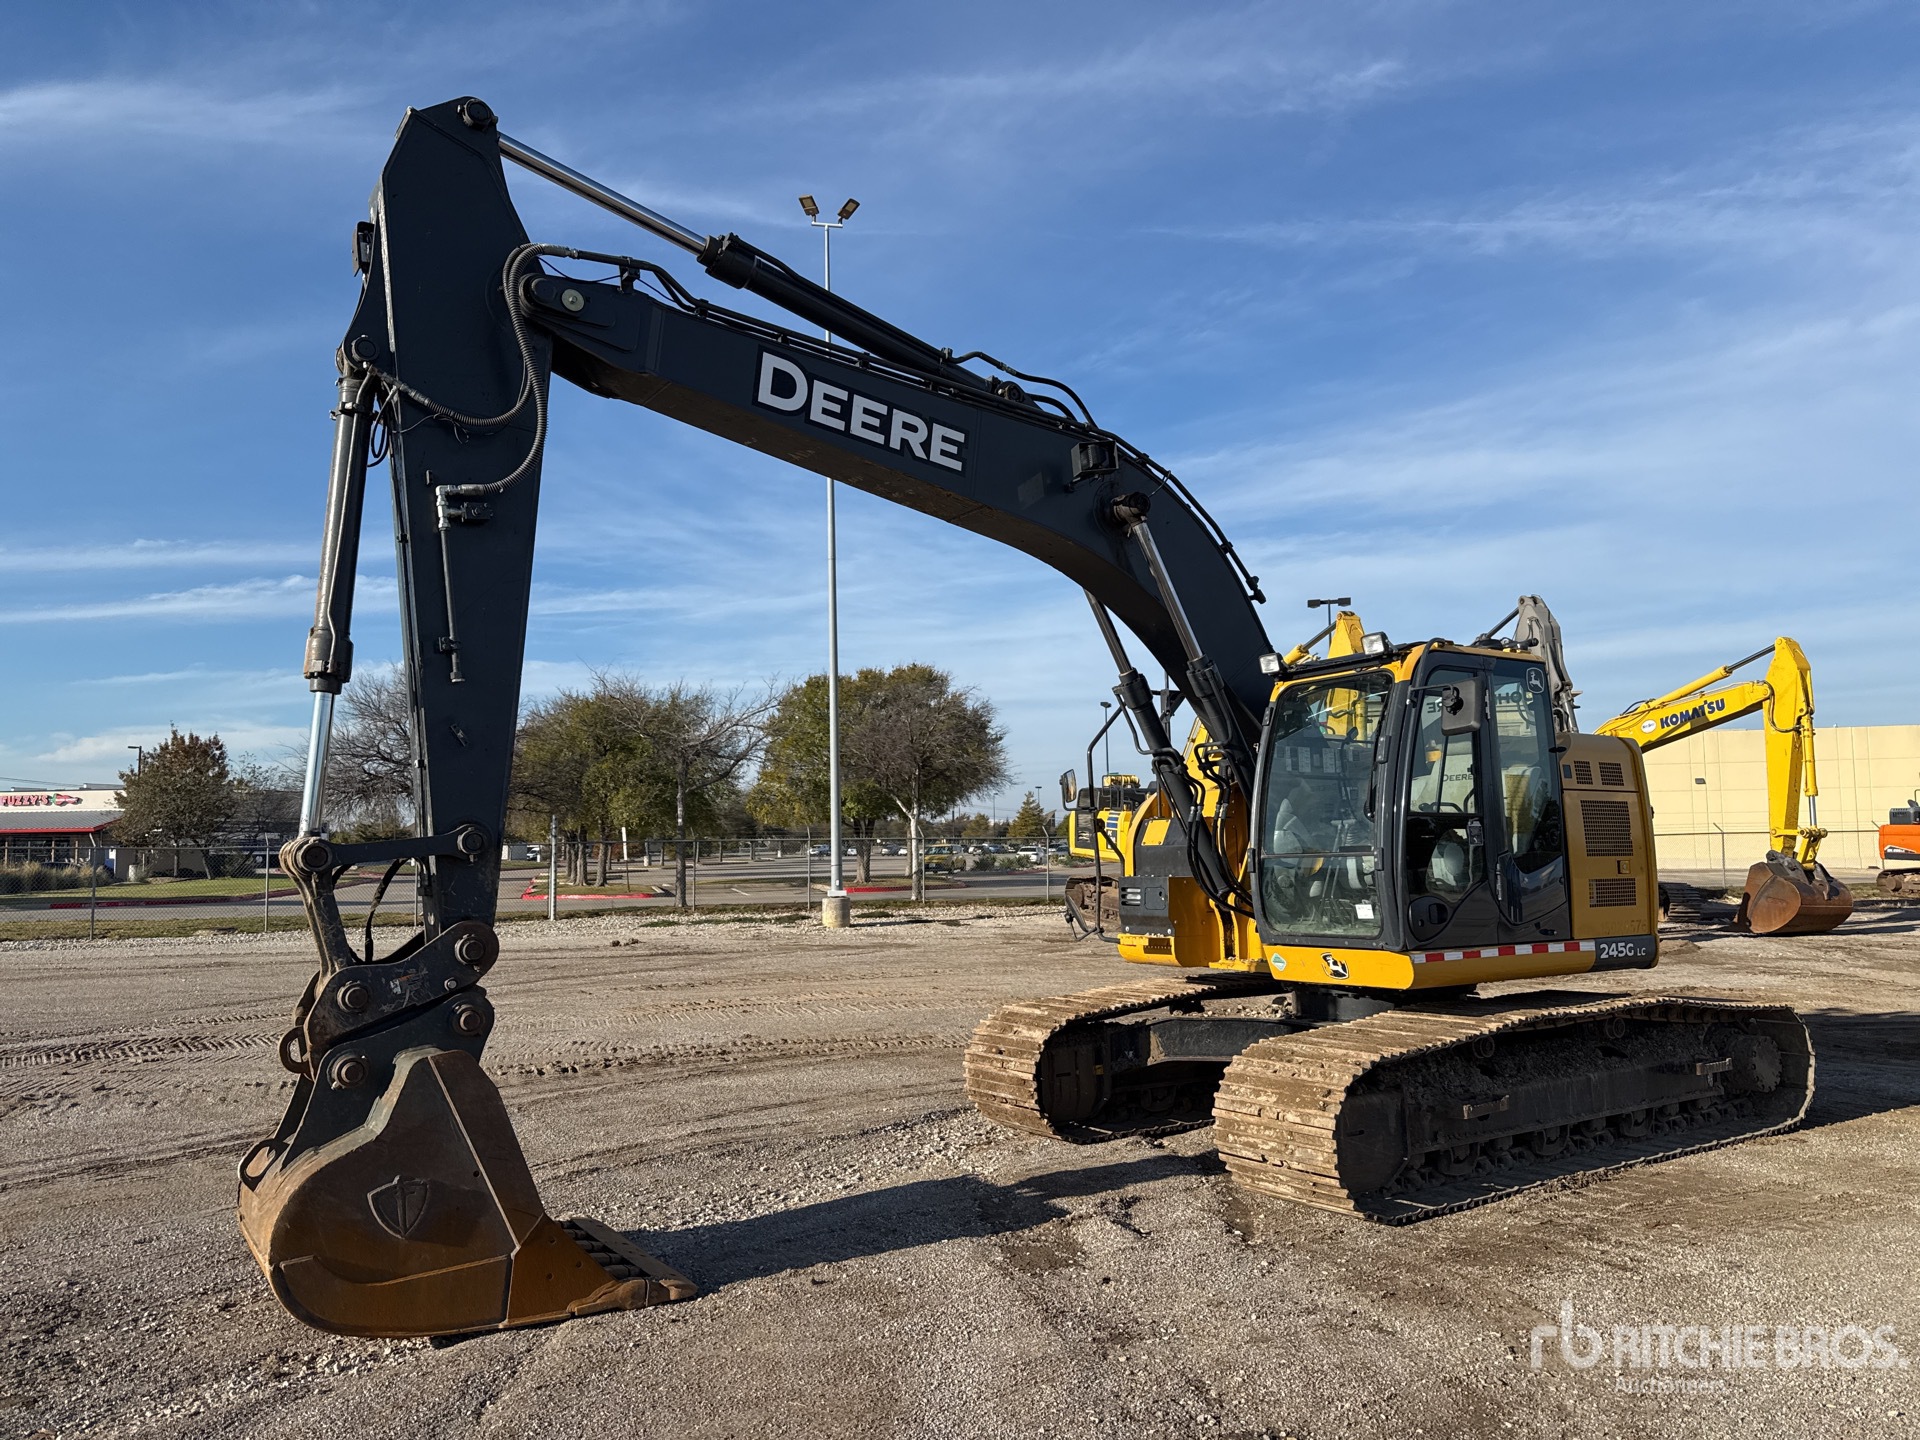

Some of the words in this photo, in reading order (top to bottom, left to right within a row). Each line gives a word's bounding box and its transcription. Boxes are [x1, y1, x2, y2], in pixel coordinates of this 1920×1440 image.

[758, 352, 965, 471] DEERE
[1660, 698, 1725, 729] KOMATSU
[1600, 943, 1634, 958] 245G
[1637, 948, 1646, 956] LC
